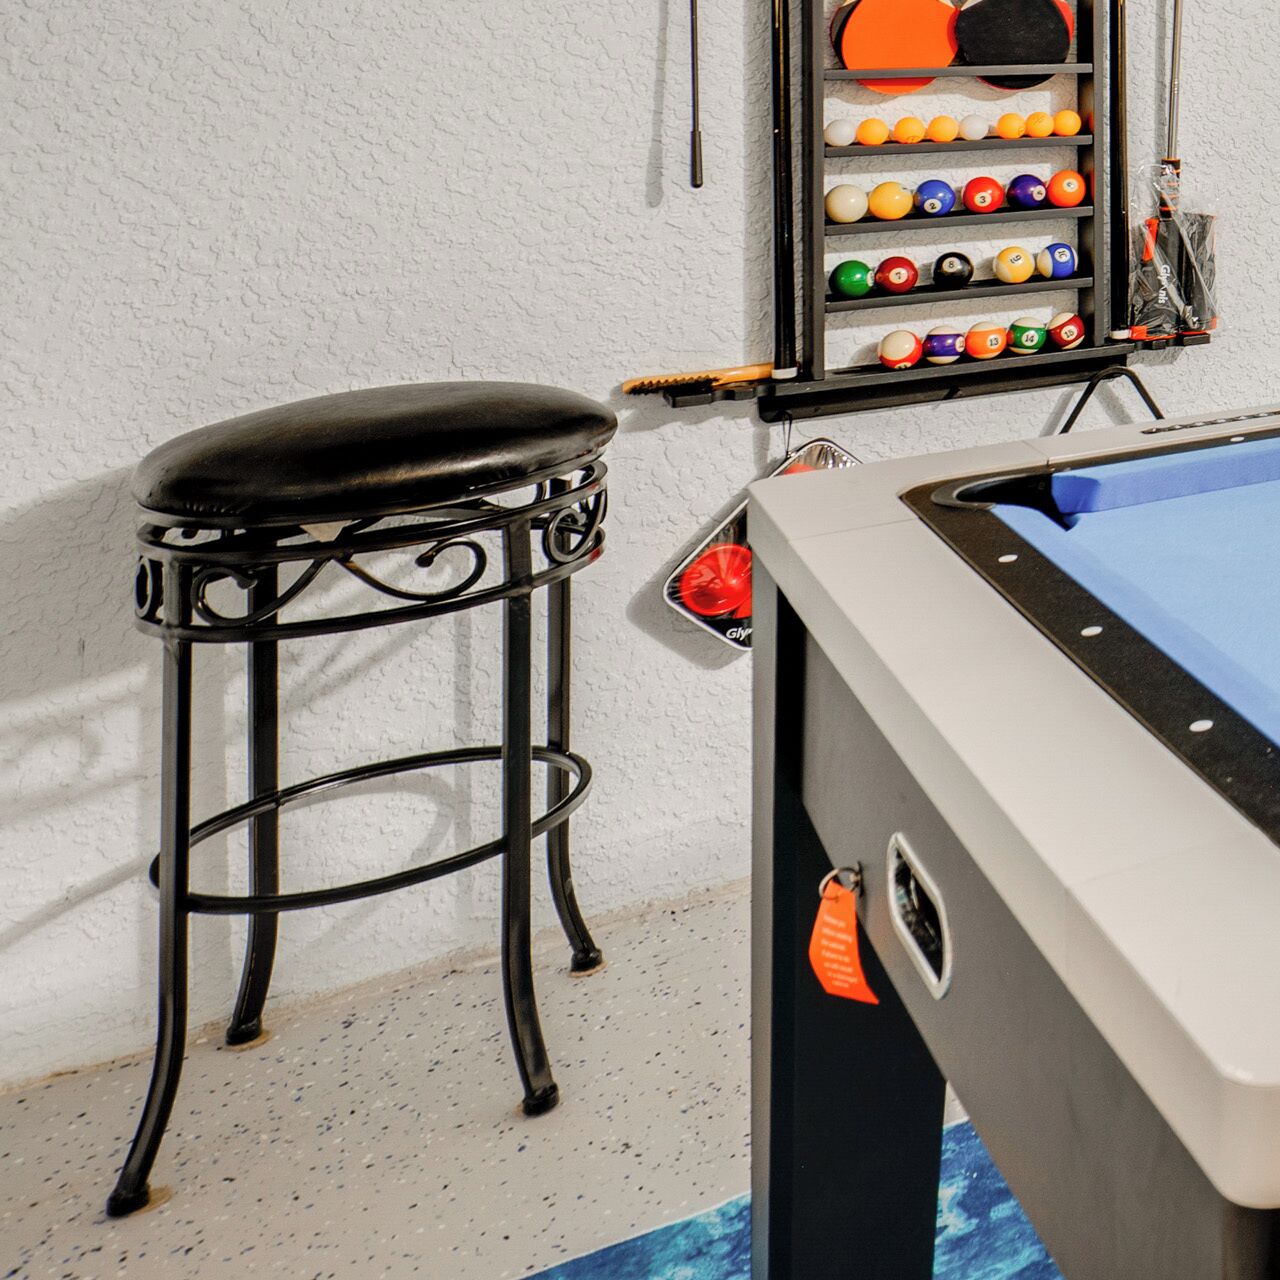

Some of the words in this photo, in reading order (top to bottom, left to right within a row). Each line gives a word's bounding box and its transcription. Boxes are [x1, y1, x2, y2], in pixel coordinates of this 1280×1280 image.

[980, 196, 987, 204] 3
[929, 202, 937, 210] 2
[948, 260, 955, 269] 8
[1025, 334, 1035, 343] 14
[1064, 329, 1075, 339] 15
[989, 337, 999, 346] 13
